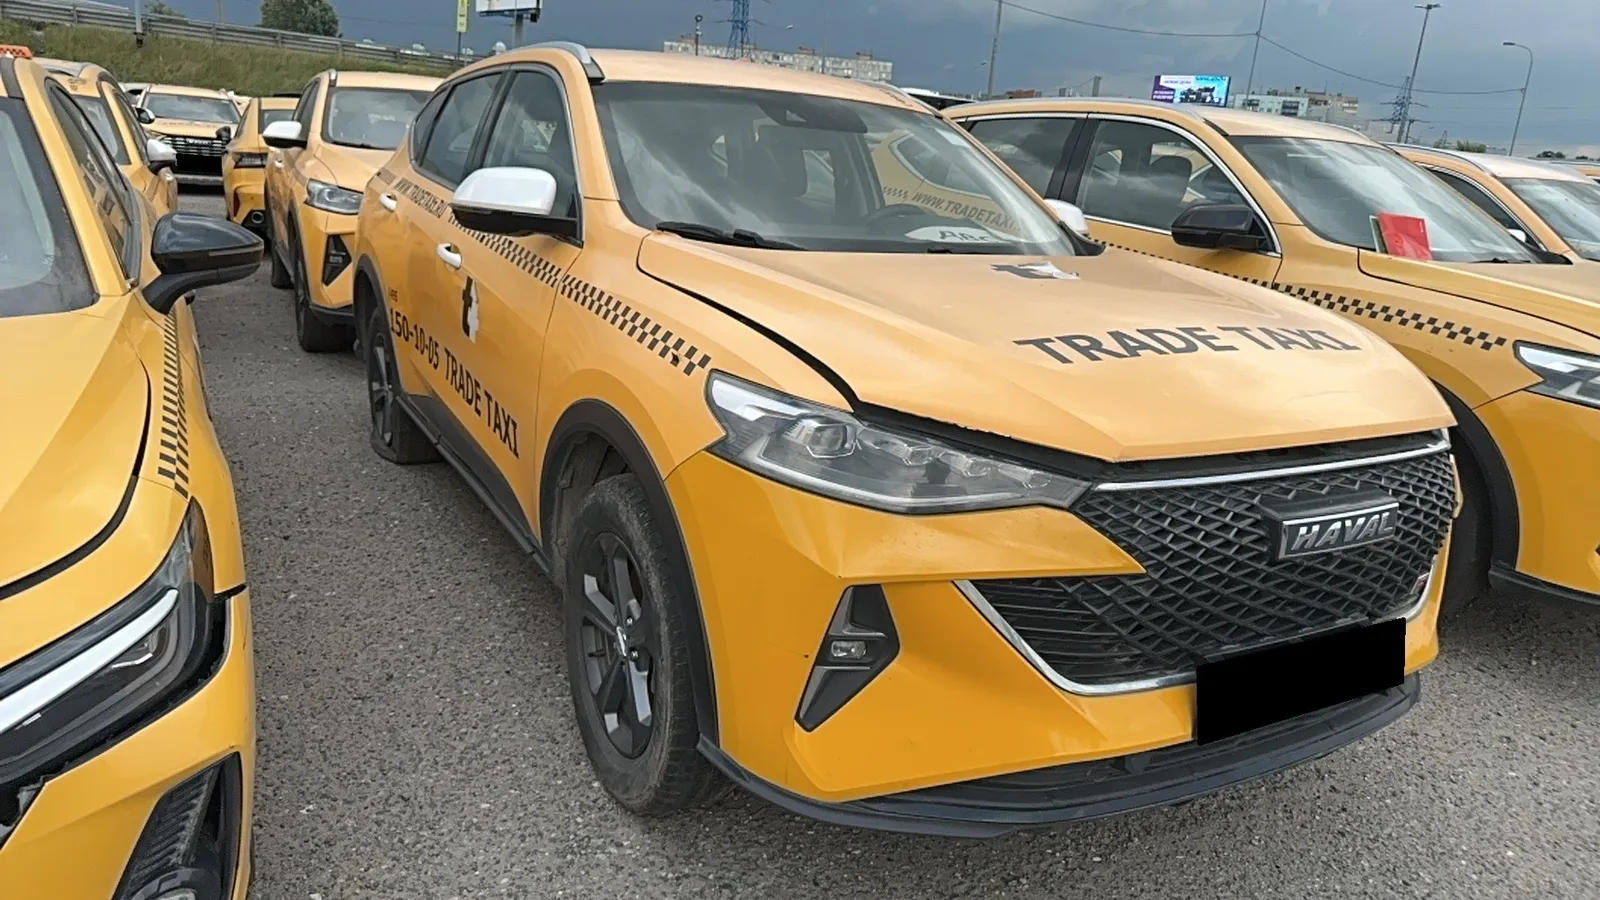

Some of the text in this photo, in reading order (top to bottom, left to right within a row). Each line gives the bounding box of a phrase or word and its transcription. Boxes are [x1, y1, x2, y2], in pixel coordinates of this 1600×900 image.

[912, 192, 1021, 231] WWW.TRADETAXI
[1013, 325, 1362, 364] TRADE TAXI
[390, 308, 520, 458] 150-10-05 TRADE TAXI
[1291, 512, 1393, 551] HAVAL
